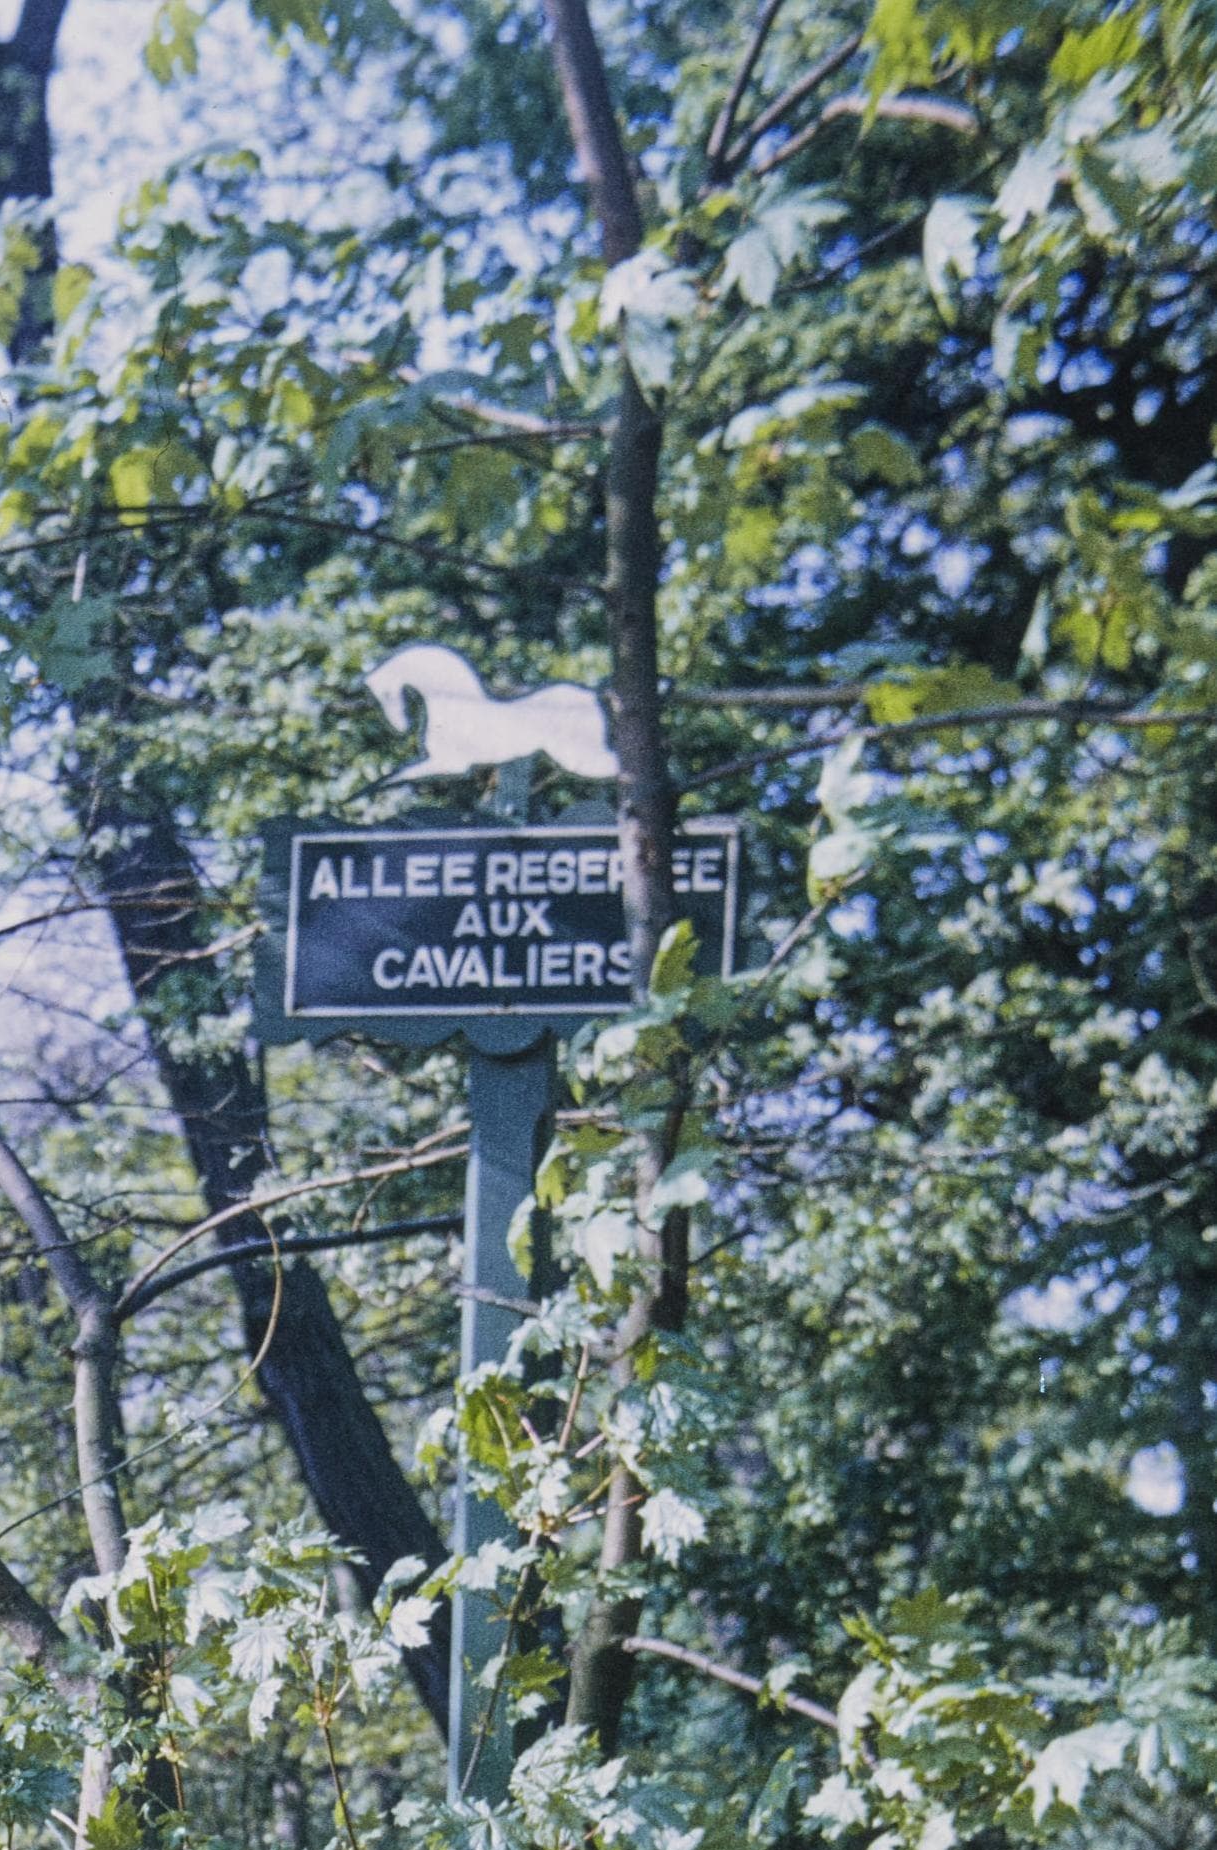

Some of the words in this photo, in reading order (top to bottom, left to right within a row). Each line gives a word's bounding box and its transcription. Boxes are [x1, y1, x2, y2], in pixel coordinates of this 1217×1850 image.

[309, 852, 477, 899] ALLEE
[485, 847, 724, 896] RESEEE
[452, 899, 553, 938] AUX
[372, 940, 633, 990] CAVALIERS
